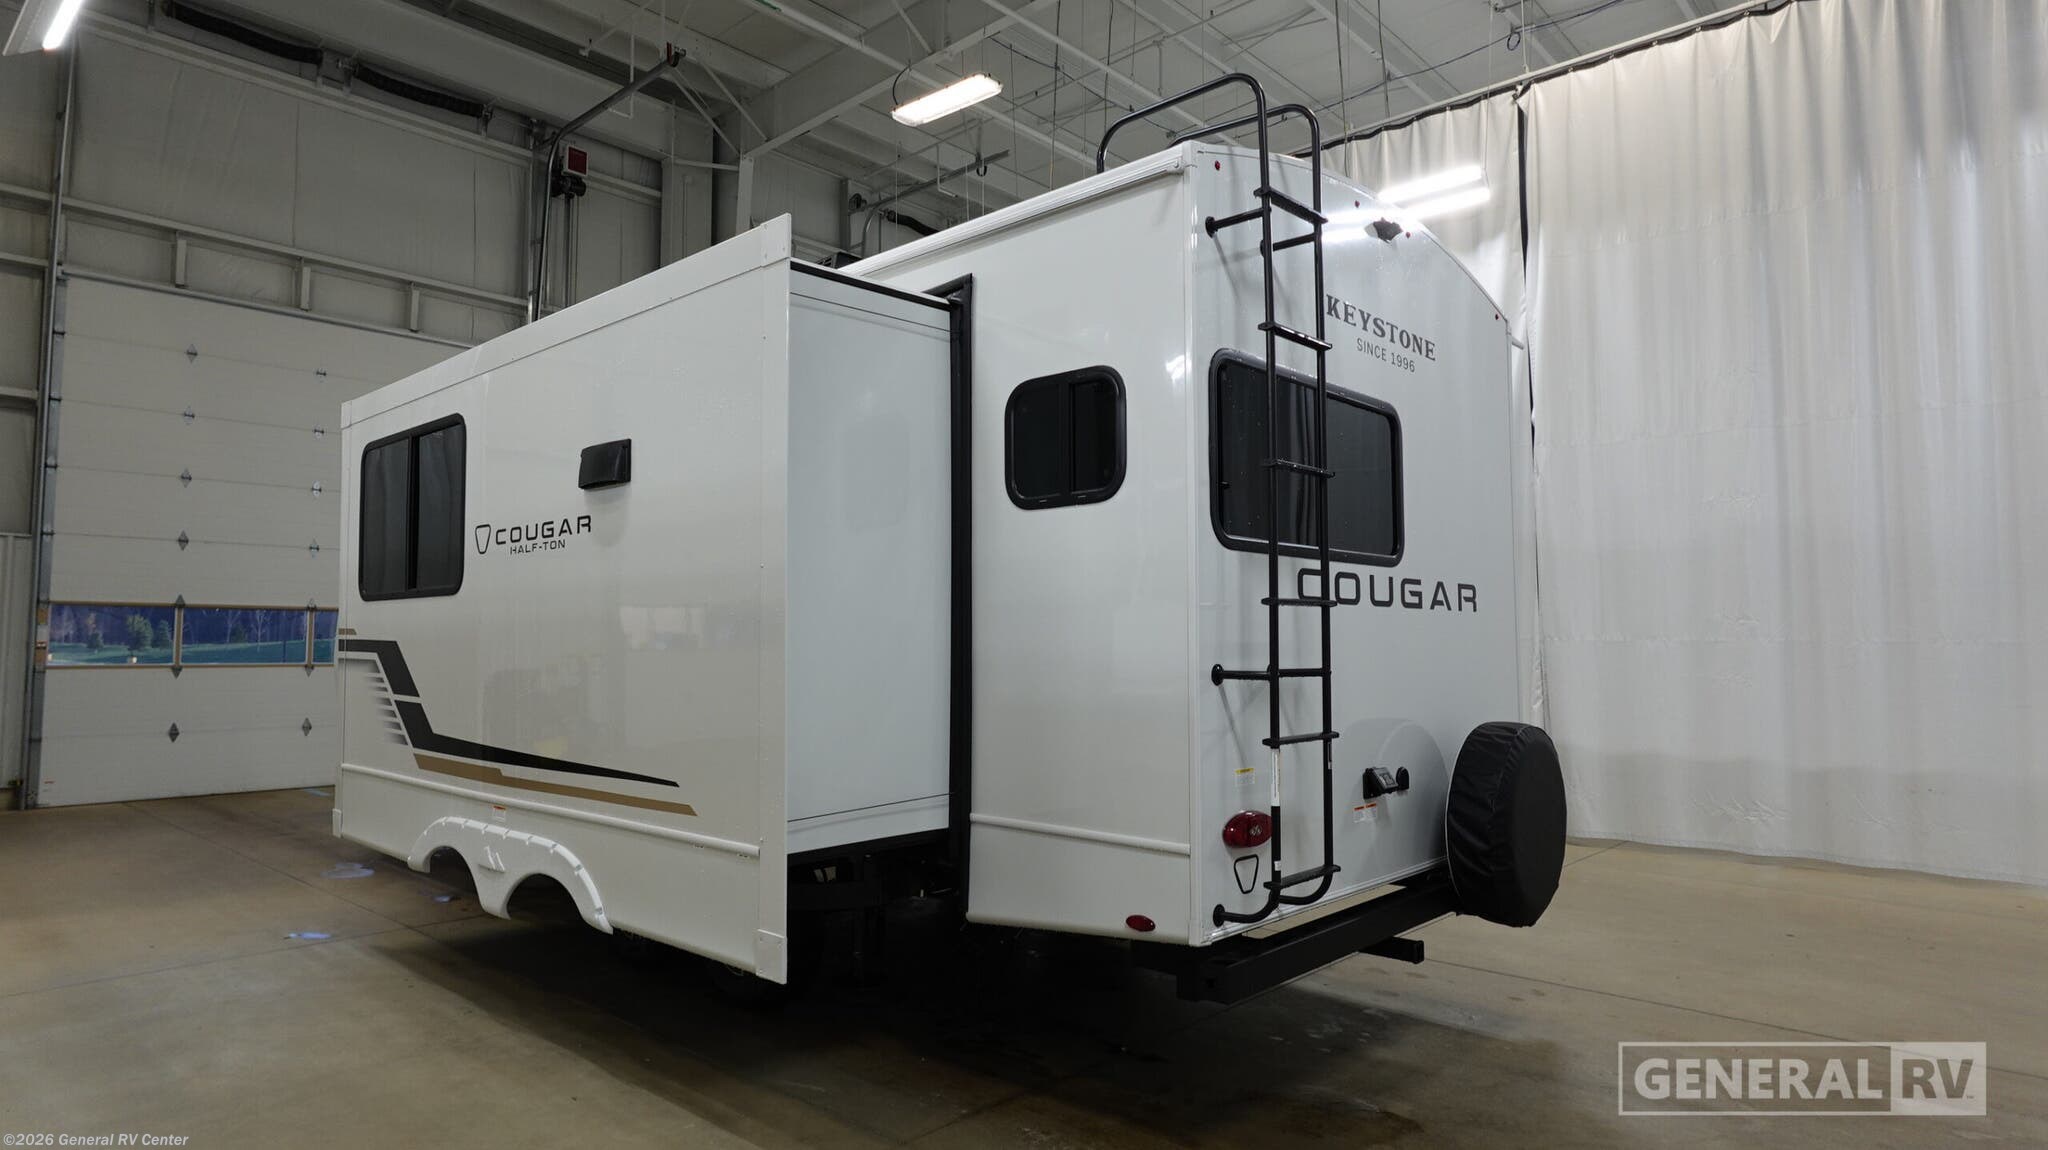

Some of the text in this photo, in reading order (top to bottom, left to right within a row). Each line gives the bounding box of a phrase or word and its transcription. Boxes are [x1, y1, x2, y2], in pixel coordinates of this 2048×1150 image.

[1326, 294, 1436, 361] KEYSTONE
[1356, 337, 1416, 373] SINCE 1996
[495, 515, 592, 545] COUGAR
[509, 539, 566, 555] HALF-TON
[1297, 567, 1478, 613] COUGAR
